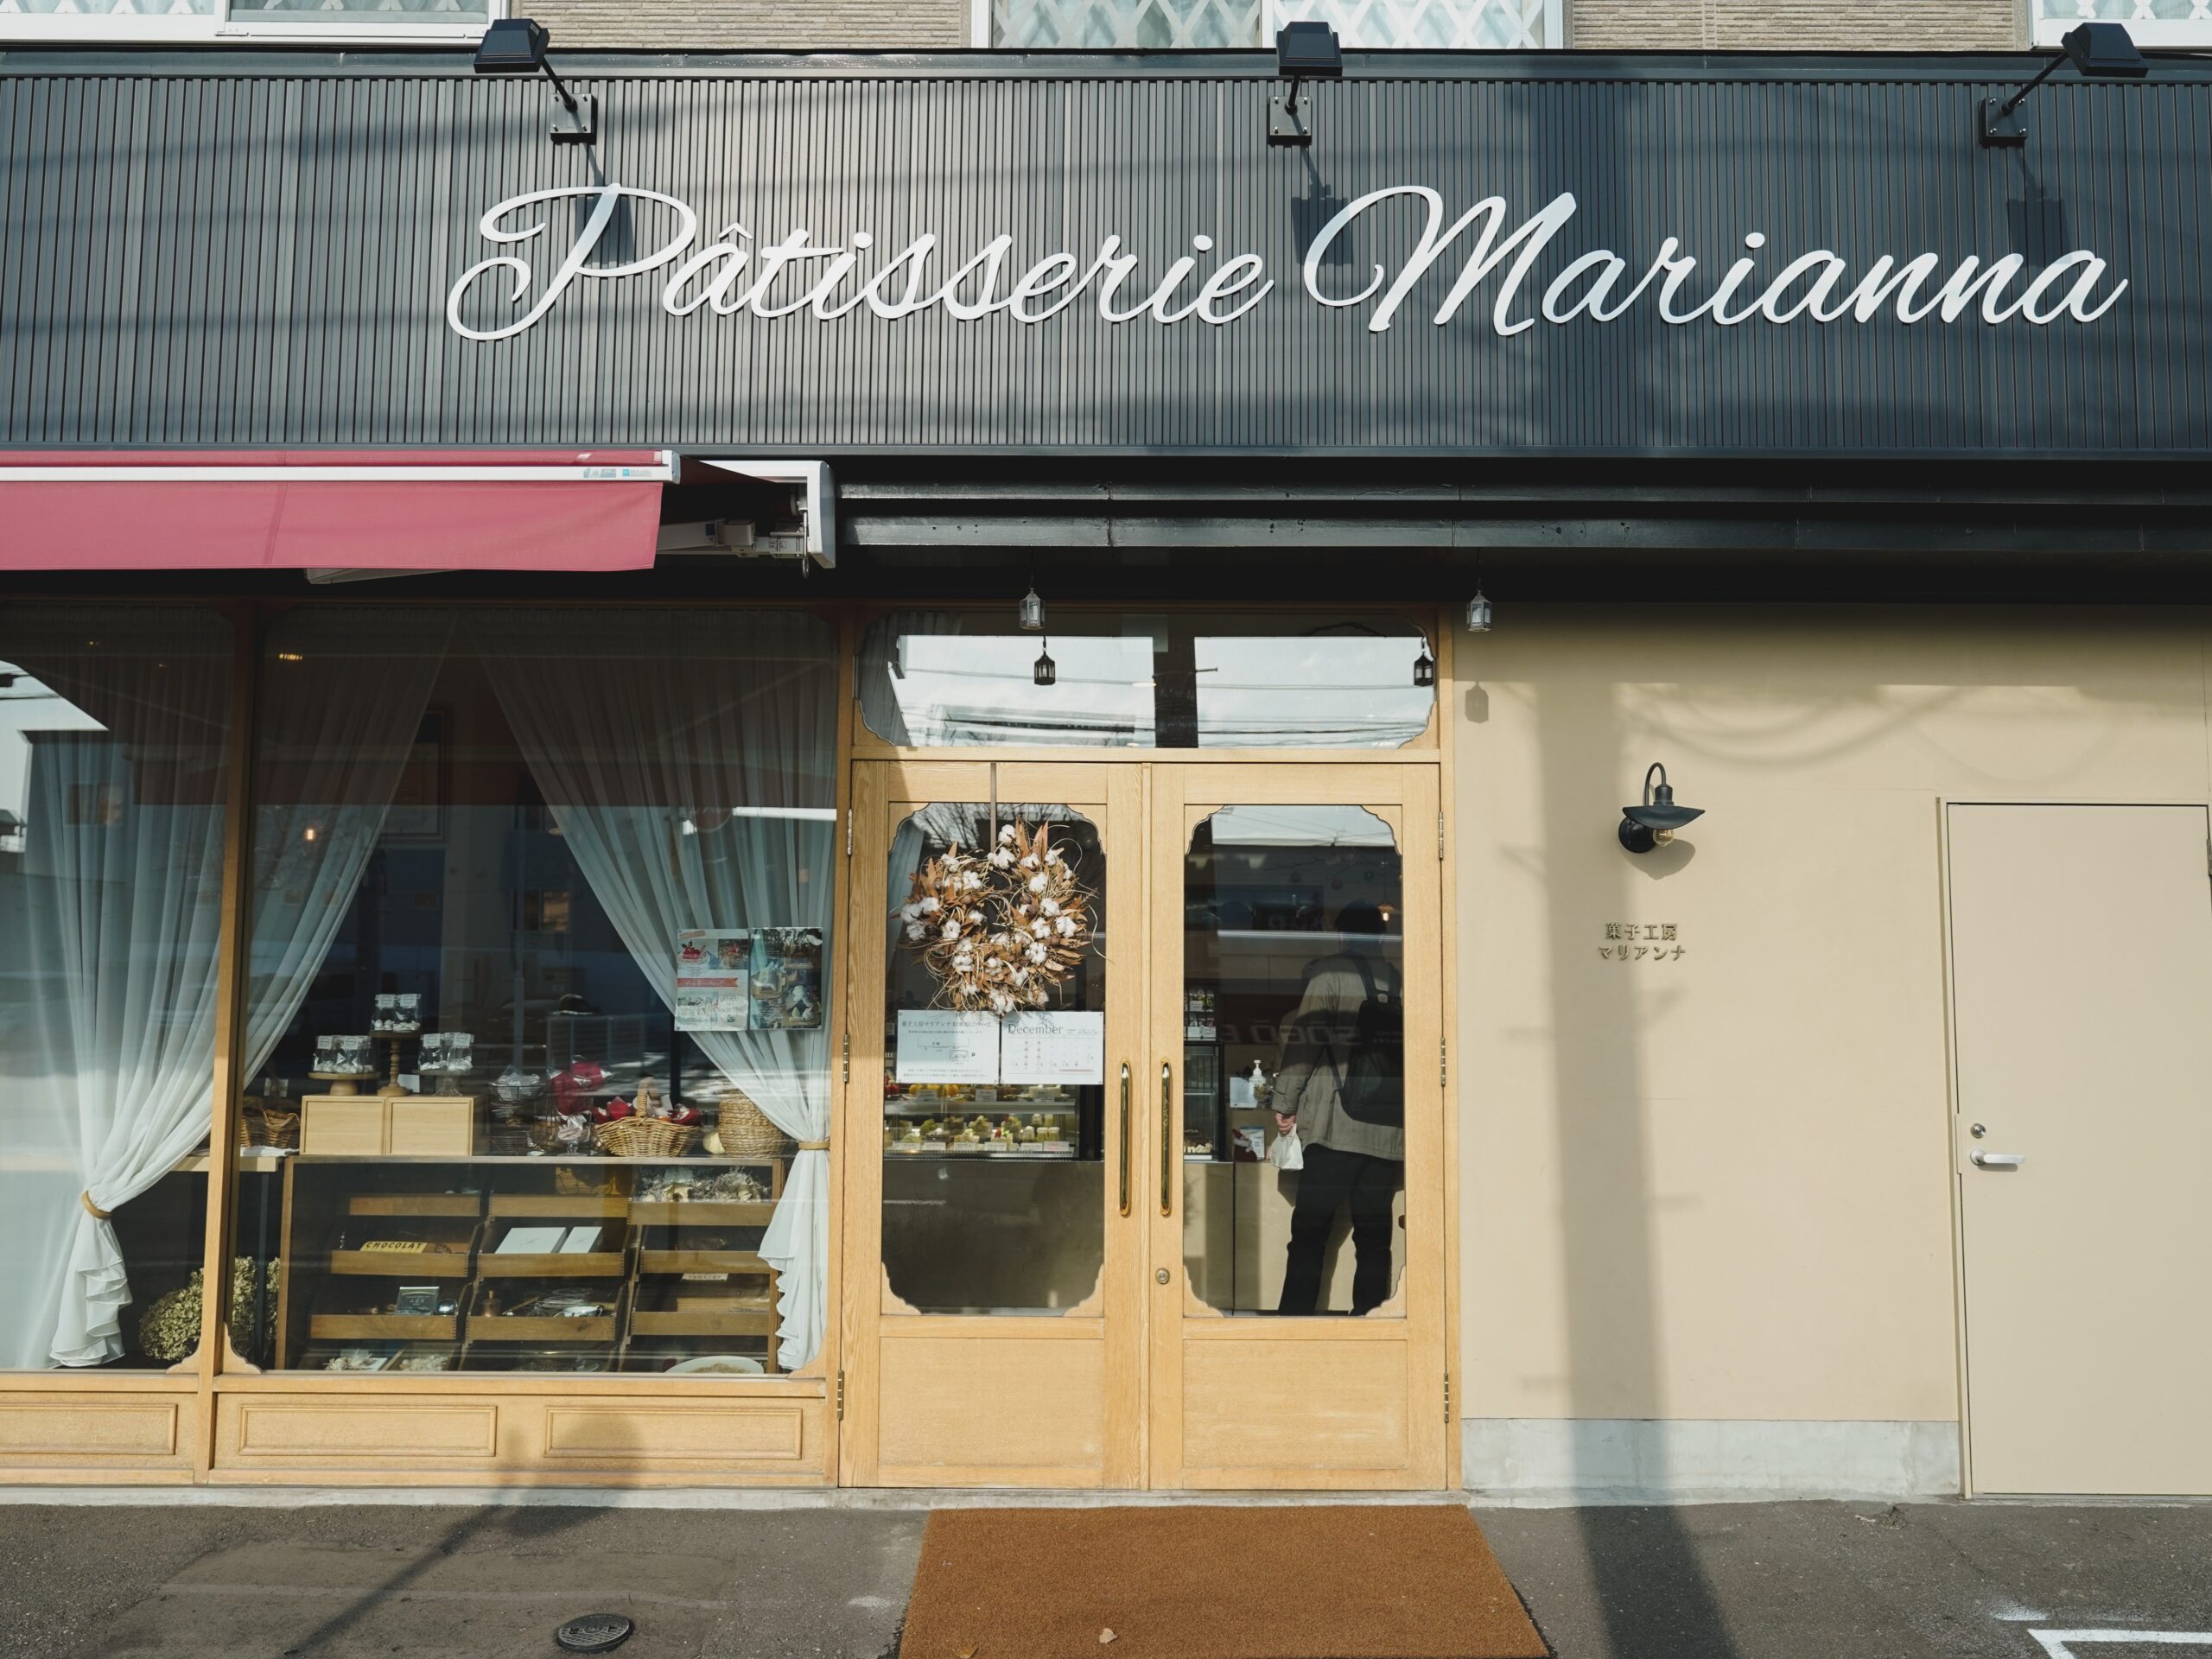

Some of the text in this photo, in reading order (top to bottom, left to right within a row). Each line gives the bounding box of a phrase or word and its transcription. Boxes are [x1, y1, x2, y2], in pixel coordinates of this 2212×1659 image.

[448, 183, 2128, 340] Pâtisserie Marianna
[1606, 923, 1677, 941] 菓子工房
[1598, 945, 1686, 961] マリアンナ
[1007, 1023, 1064, 1034] December
